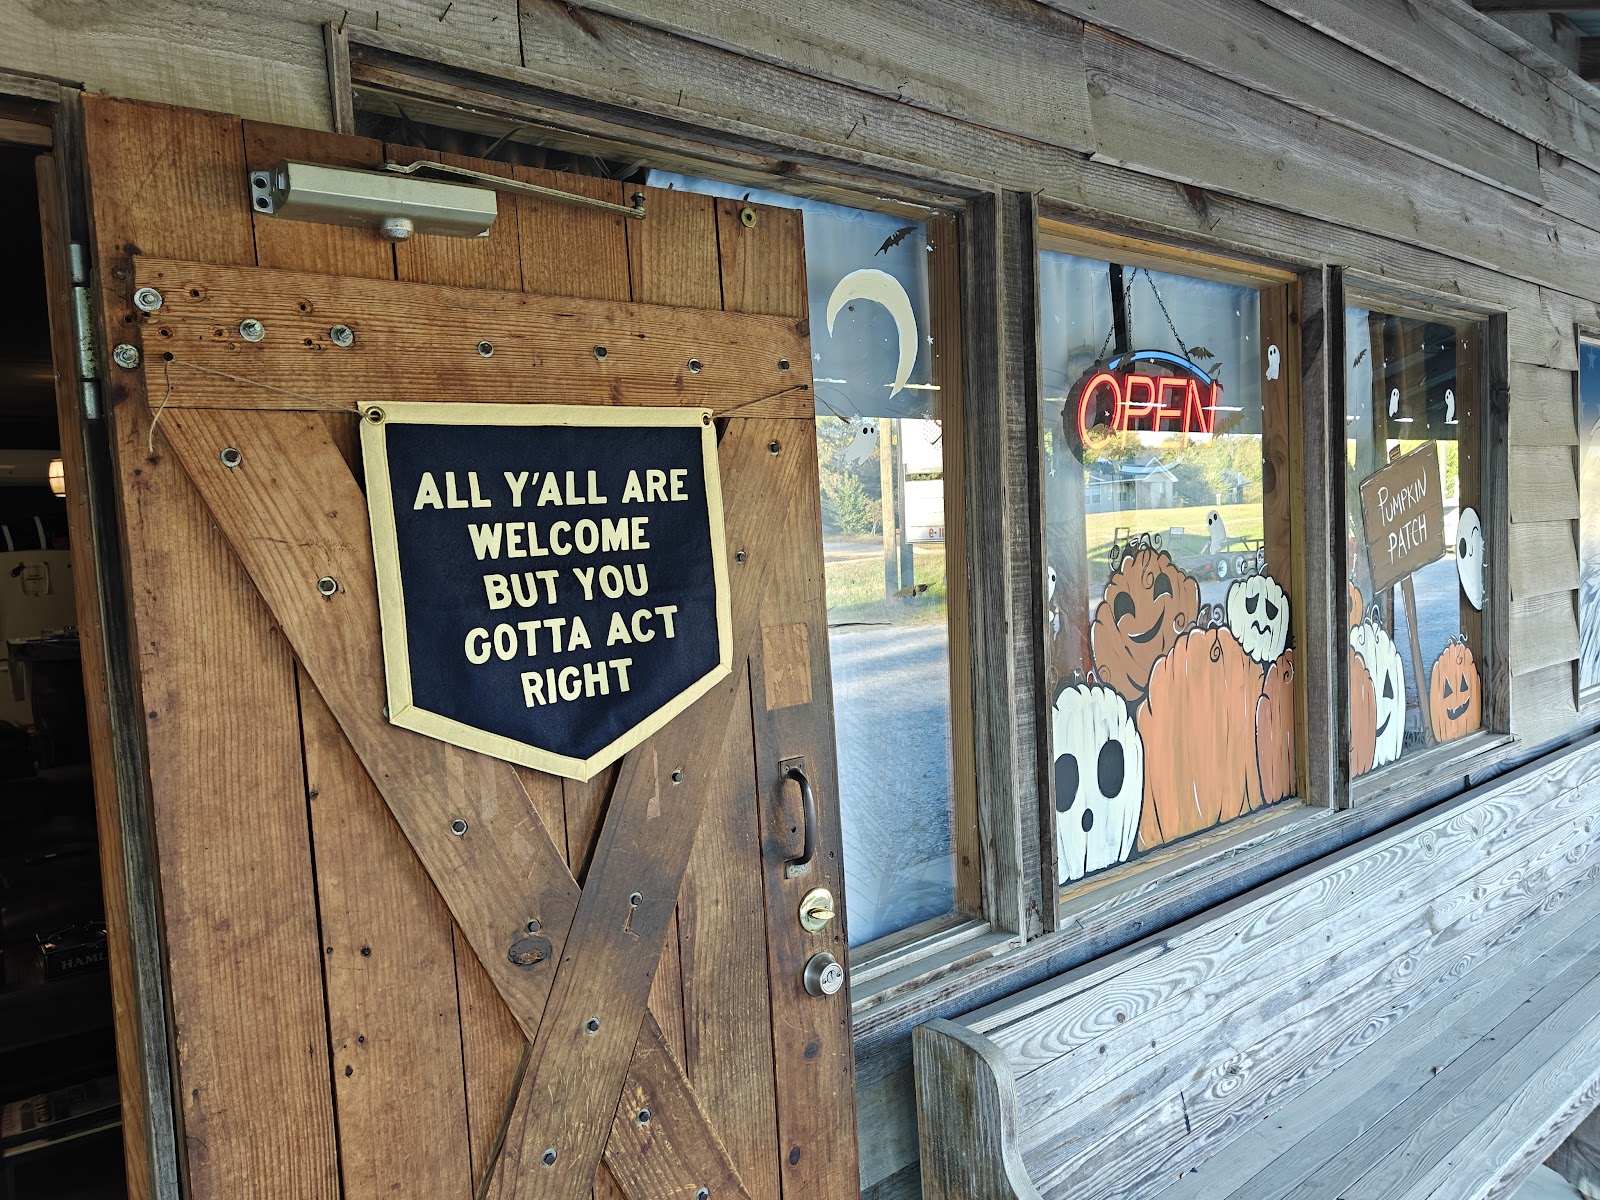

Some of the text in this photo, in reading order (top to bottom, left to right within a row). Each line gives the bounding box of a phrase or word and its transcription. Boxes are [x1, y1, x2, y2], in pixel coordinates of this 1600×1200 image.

[1077, 373, 1218, 450] OPEN
[413, 468, 689, 510] ALL Y'ALL ARE
[1377, 465, 1427, 526] PUMPKIN
[467, 517, 650, 560] WELCOME
[1388, 514, 1428, 565] PATCH
[483, 563, 649, 610] BUT YOU
[464, 605, 678, 664] GOTTA ACT
[520, 658, 633, 708] RIGHT
